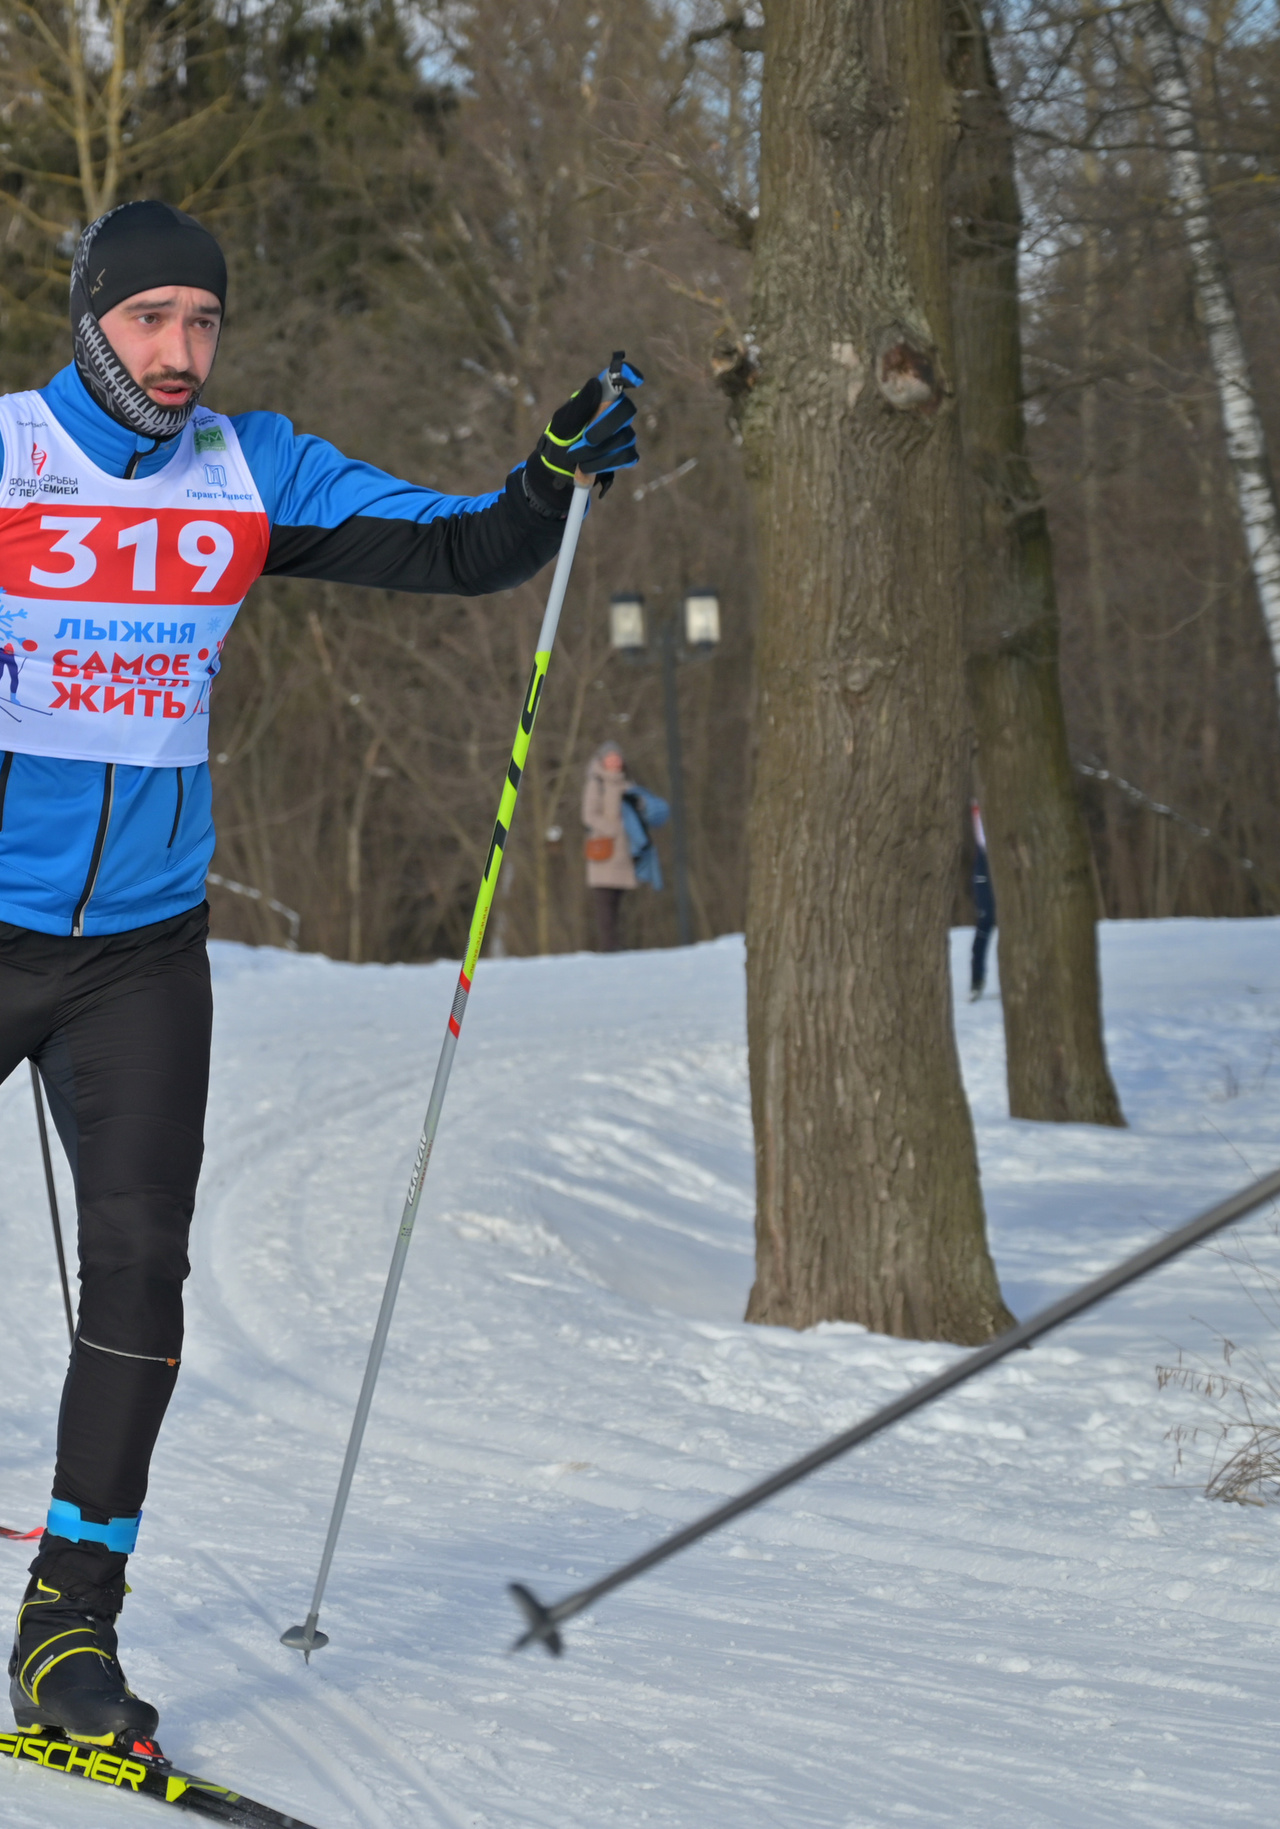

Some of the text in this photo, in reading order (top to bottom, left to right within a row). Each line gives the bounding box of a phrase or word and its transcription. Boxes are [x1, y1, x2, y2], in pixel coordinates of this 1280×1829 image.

[9, 477, 37, 488] ФОНД
[29, 515, 234, 592] 319
[54, 618, 196, 643] ЛЫЖНЯ
[53, 649, 190, 676] САМОЕ
[49, 681, 186, 718] ЖИТЬ
